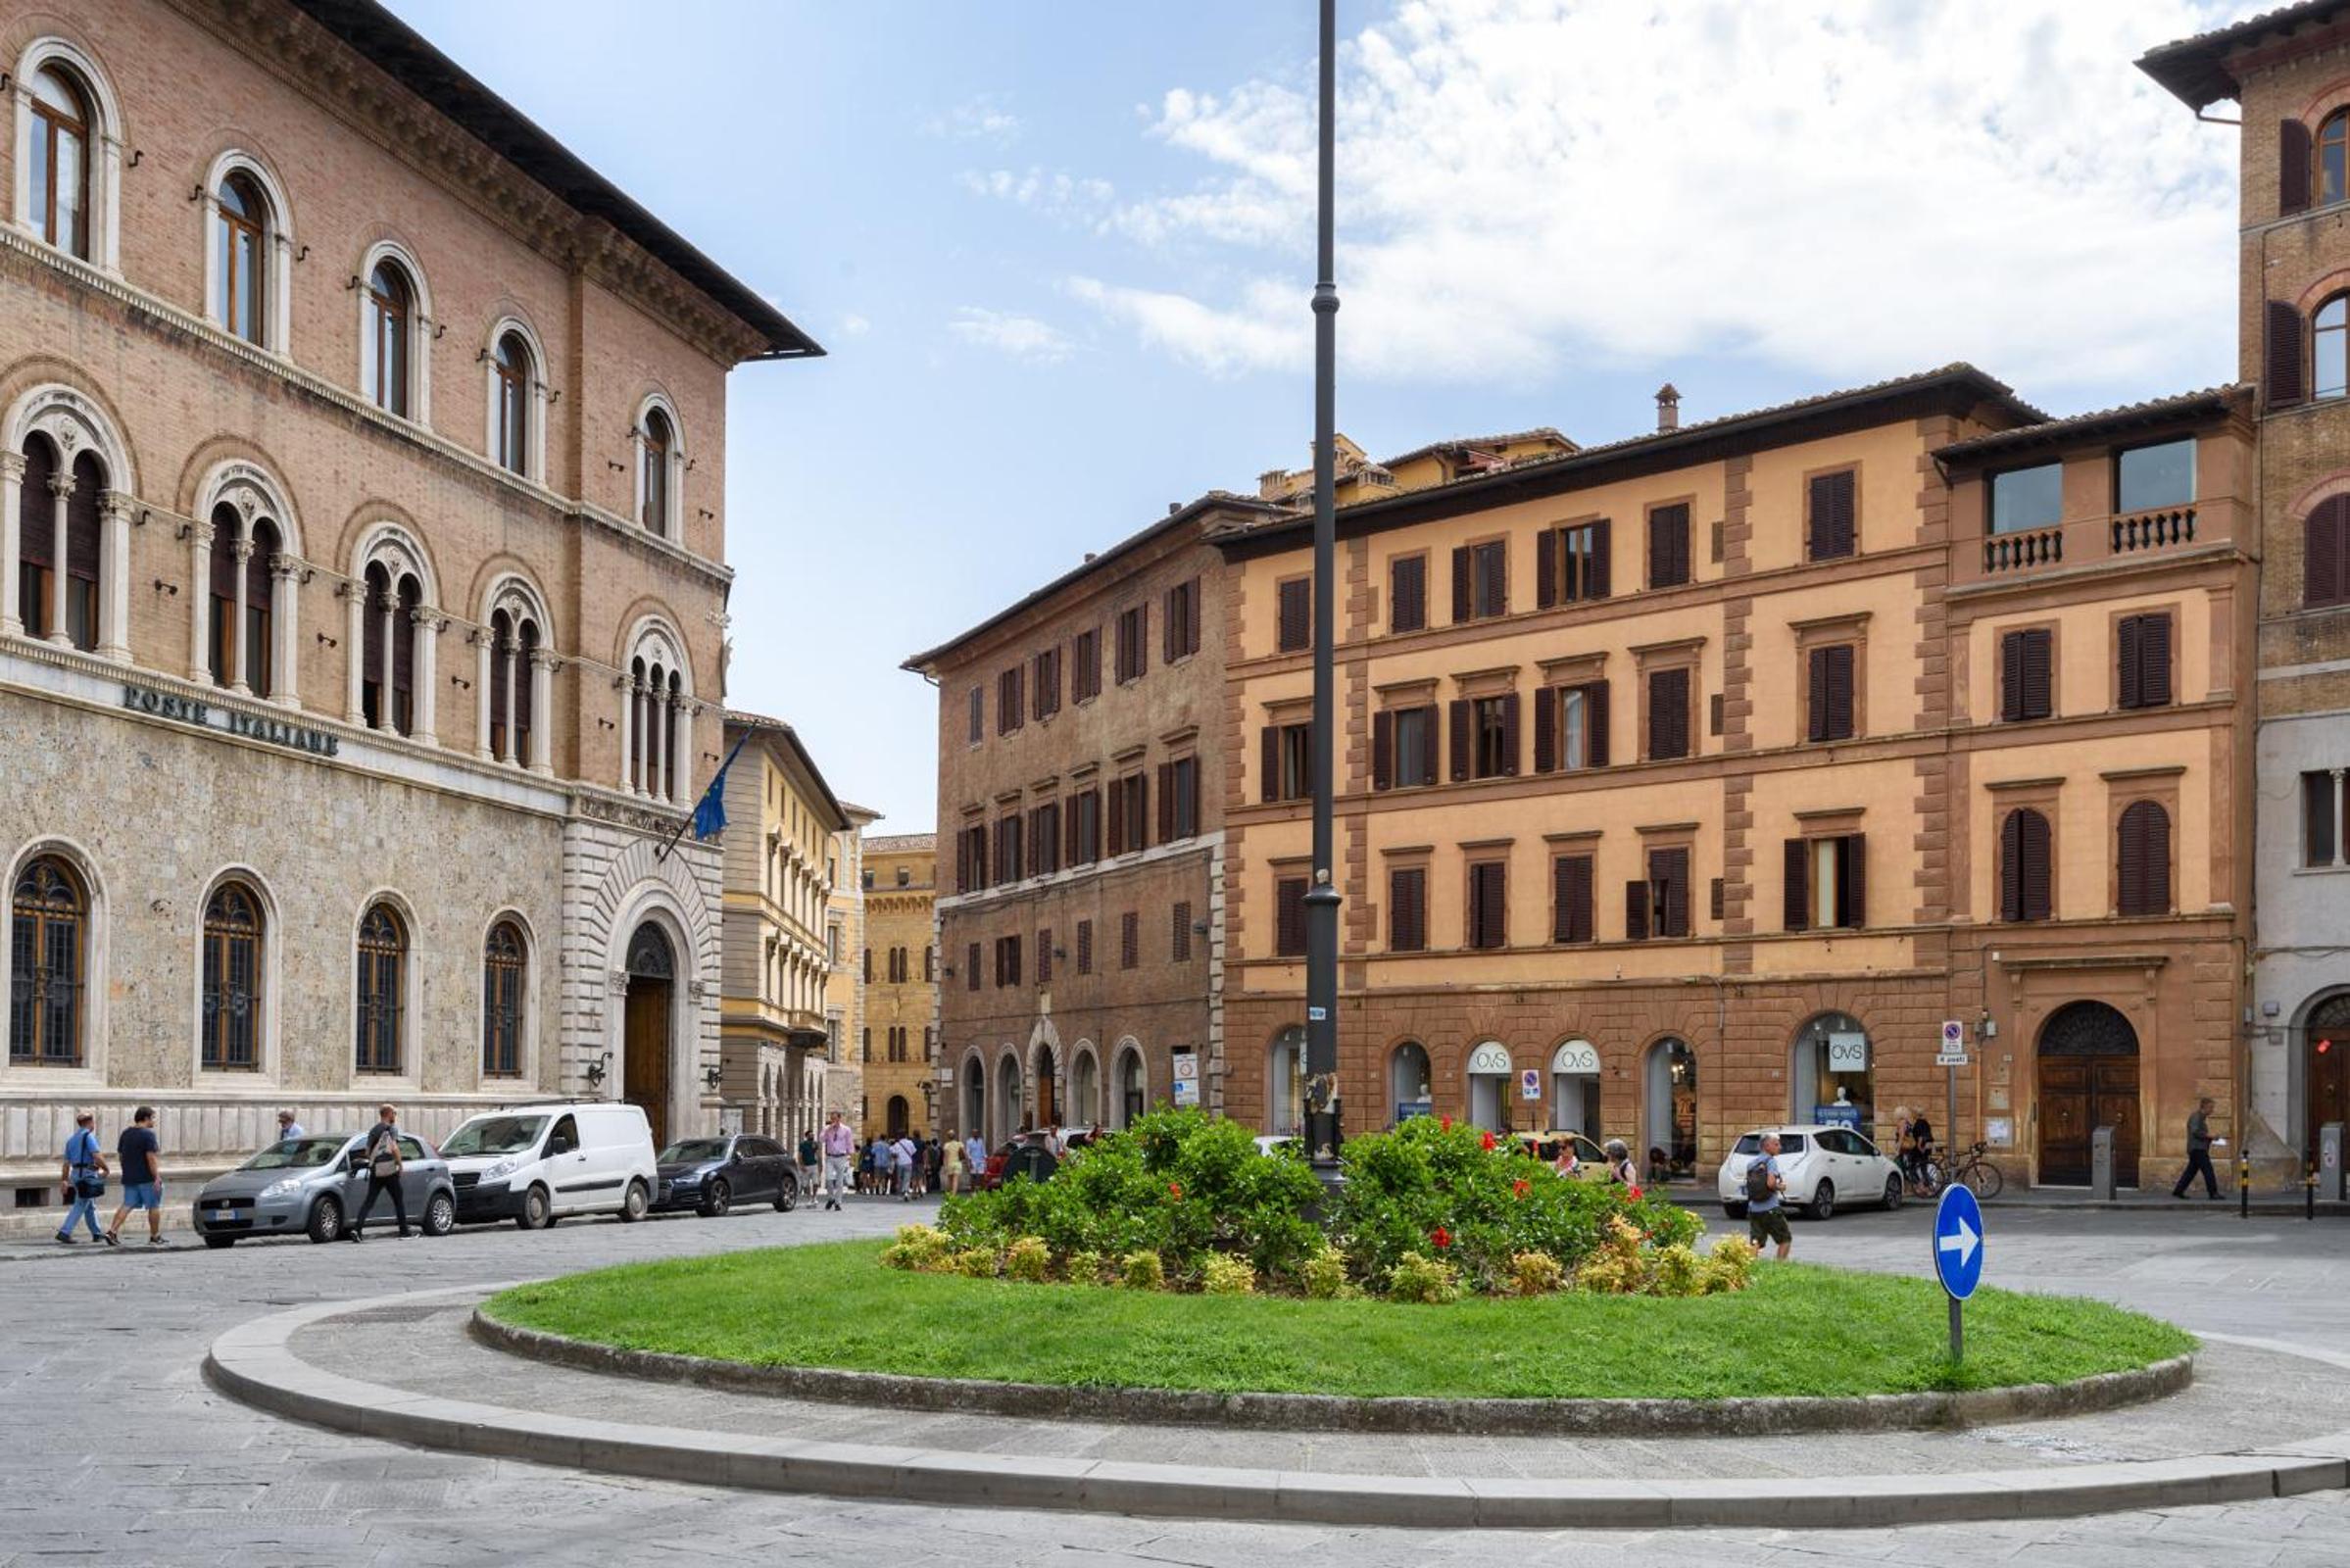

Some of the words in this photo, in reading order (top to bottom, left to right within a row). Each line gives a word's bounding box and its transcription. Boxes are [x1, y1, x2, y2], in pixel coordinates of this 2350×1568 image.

[124, 685, 207, 725] POSTE
[230, 711, 339, 756] ITALIANE
[1476, 1052, 1506, 1068] OVS
[1562, 1051, 1593, 1067] OVS
[1832, 1045, 1862, 1059] OVS
